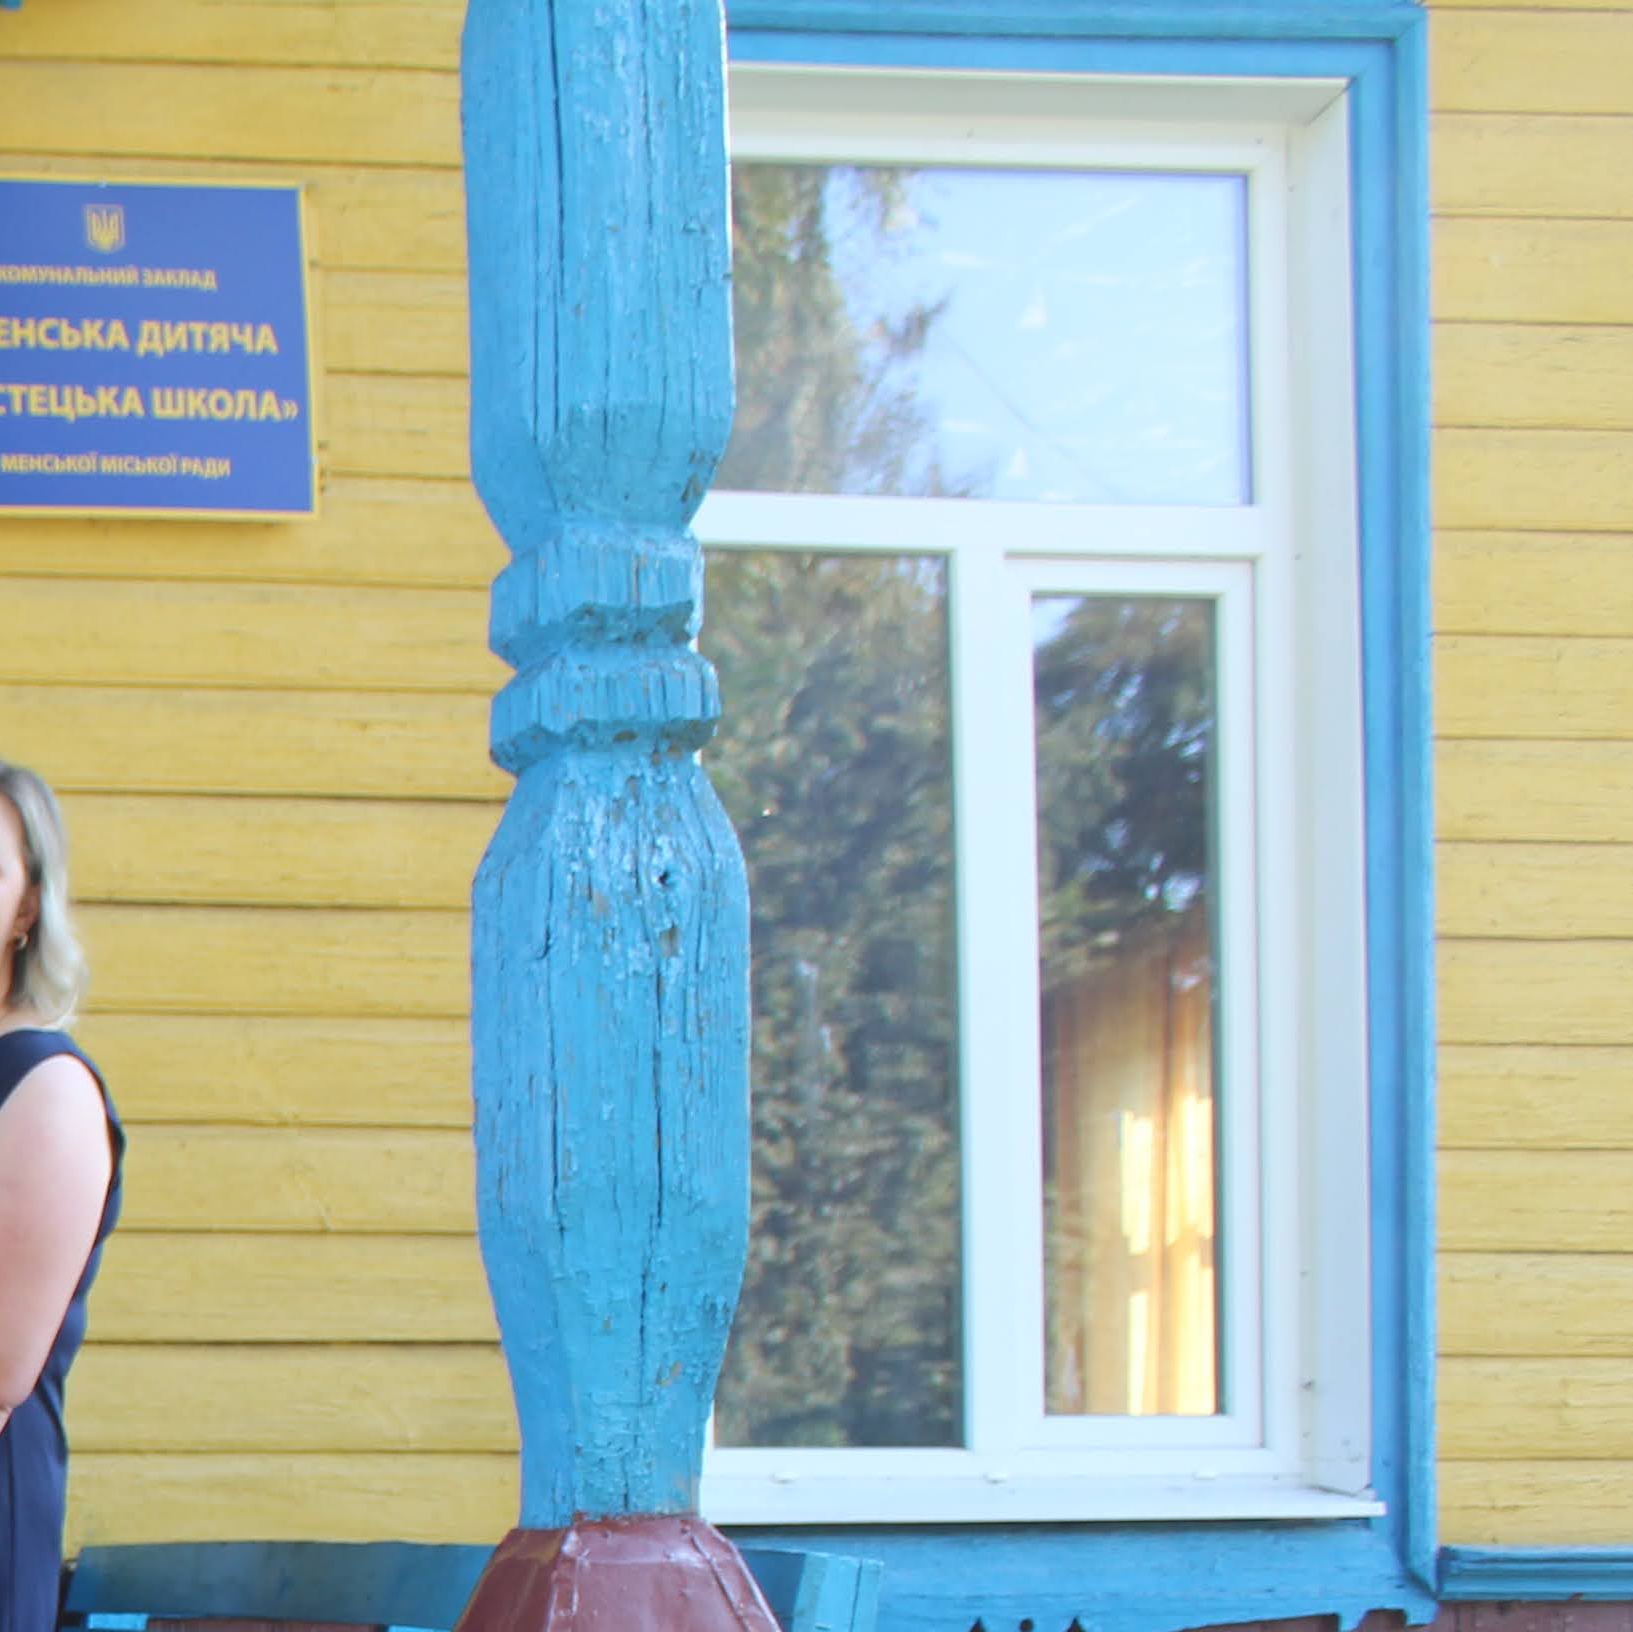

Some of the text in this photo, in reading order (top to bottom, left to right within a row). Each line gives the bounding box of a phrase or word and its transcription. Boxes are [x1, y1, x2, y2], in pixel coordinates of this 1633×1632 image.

[142, 270, 218, 291] ЗАКЛАД
[137, 322, 279, 357] ДИТЯЧА
[151, 389, 298, 421] ШКОЛА»
[0, 453, 232, 479] МЕНСЬКОЇ МІСЬКОЇ РАДИ
